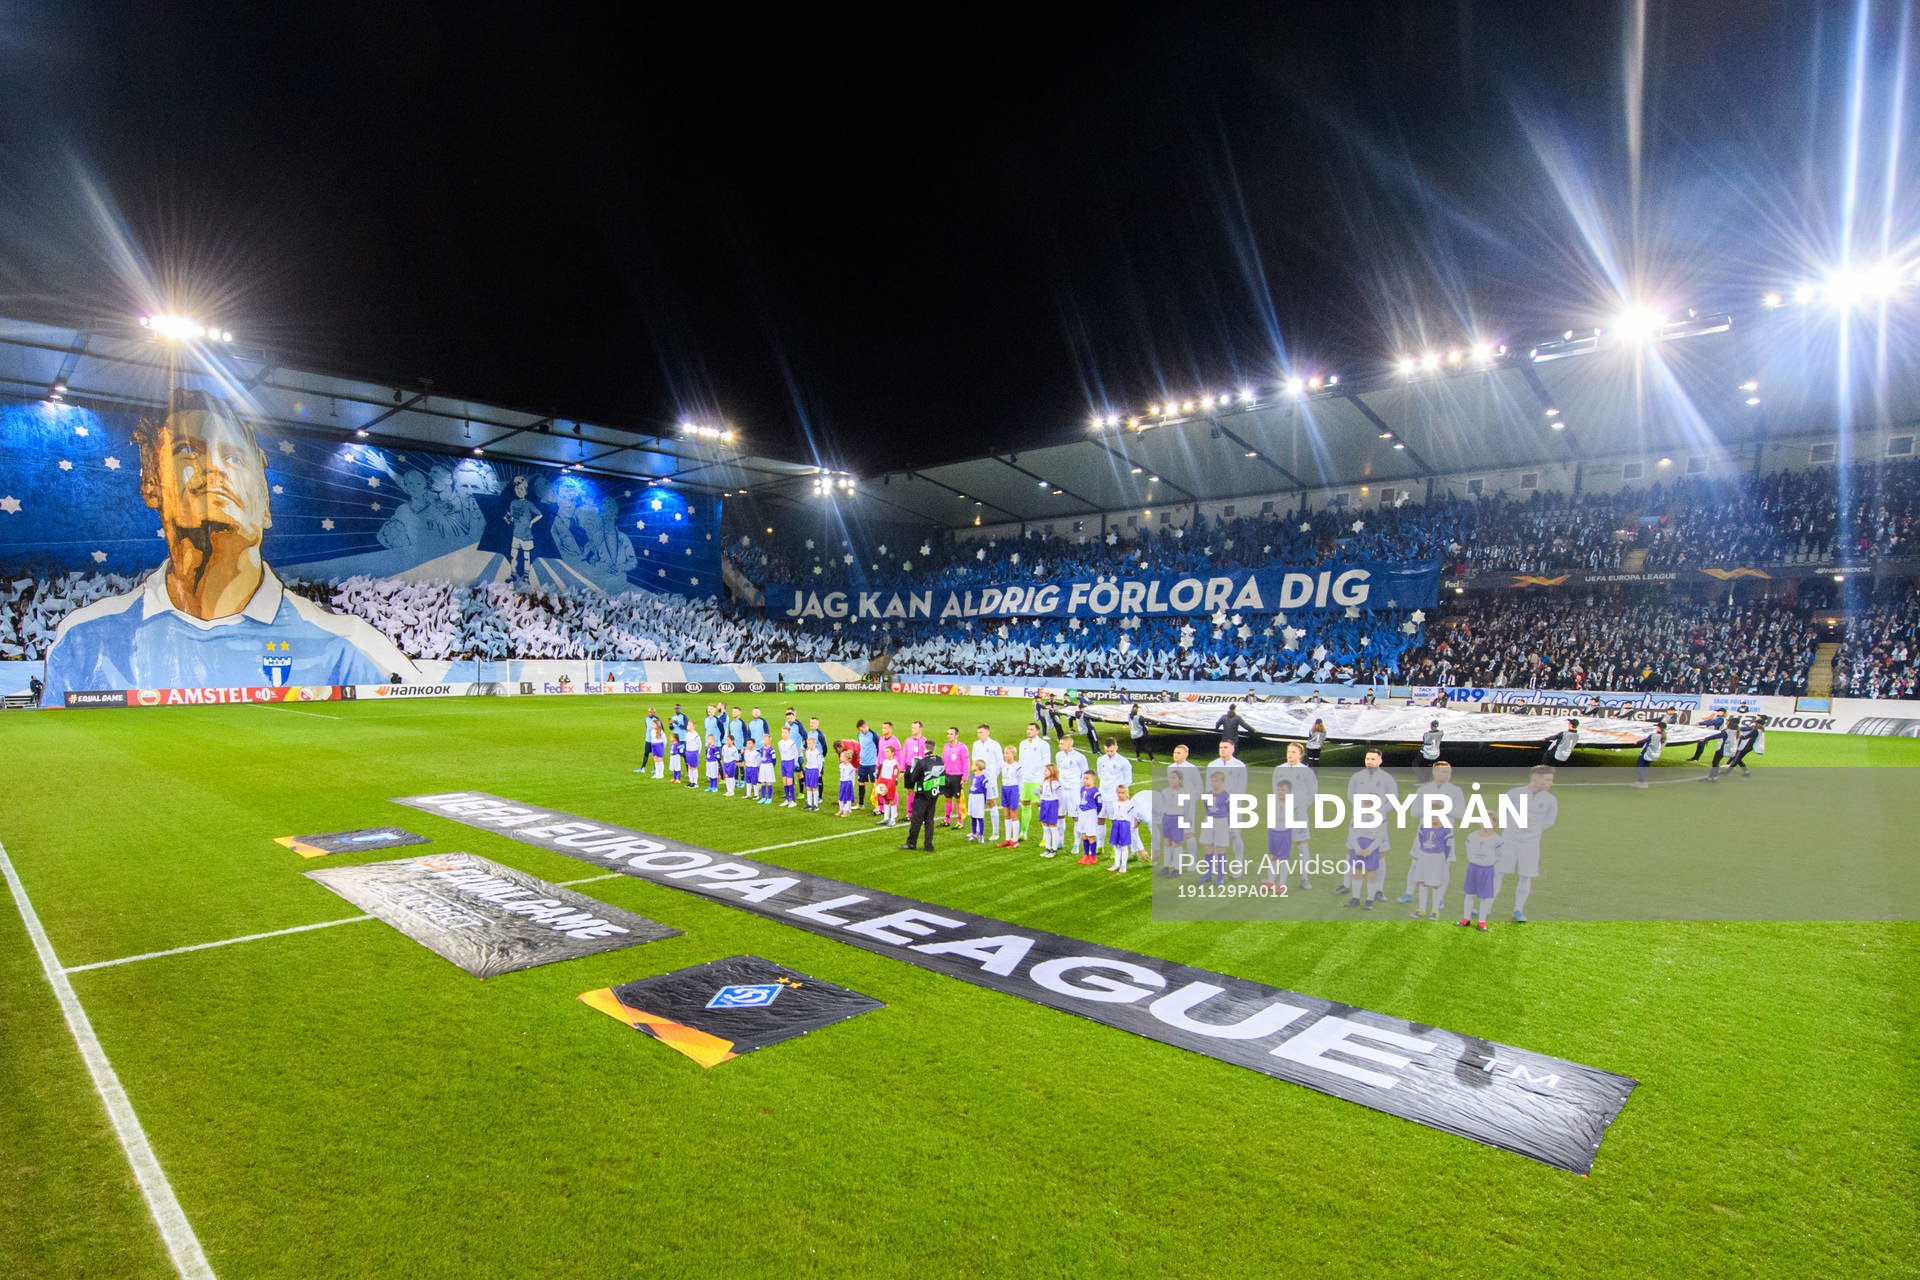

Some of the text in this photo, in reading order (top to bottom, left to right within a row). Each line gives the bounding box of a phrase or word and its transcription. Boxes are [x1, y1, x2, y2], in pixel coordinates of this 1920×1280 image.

[1585, 573, 1677, 583] UEFA EUROPA LEAGUE
[786, 569, 1372, 619] JAG KAN ALDRIG FÖRLORA DIG
[544, 682, 574, 694] FedEx
[624, 682, 652, 693] FedEx
[687, 684, 700, 692] KIA
[719, 684, 732, 692] KIA
[751, 684, 763, 692] KIA
[787, 682, 840, 692] enterprise
[902, 683, 941, 694] AMSTEL
[984, 686, 1009, 697] FedEx
[167, 688, 253, 705] AMSTEL
[415, 792, 553, 828] UEFA
[514, 822, 801, 904] EUROPA
[786, 894, 1440, 1090] LEAGUE
